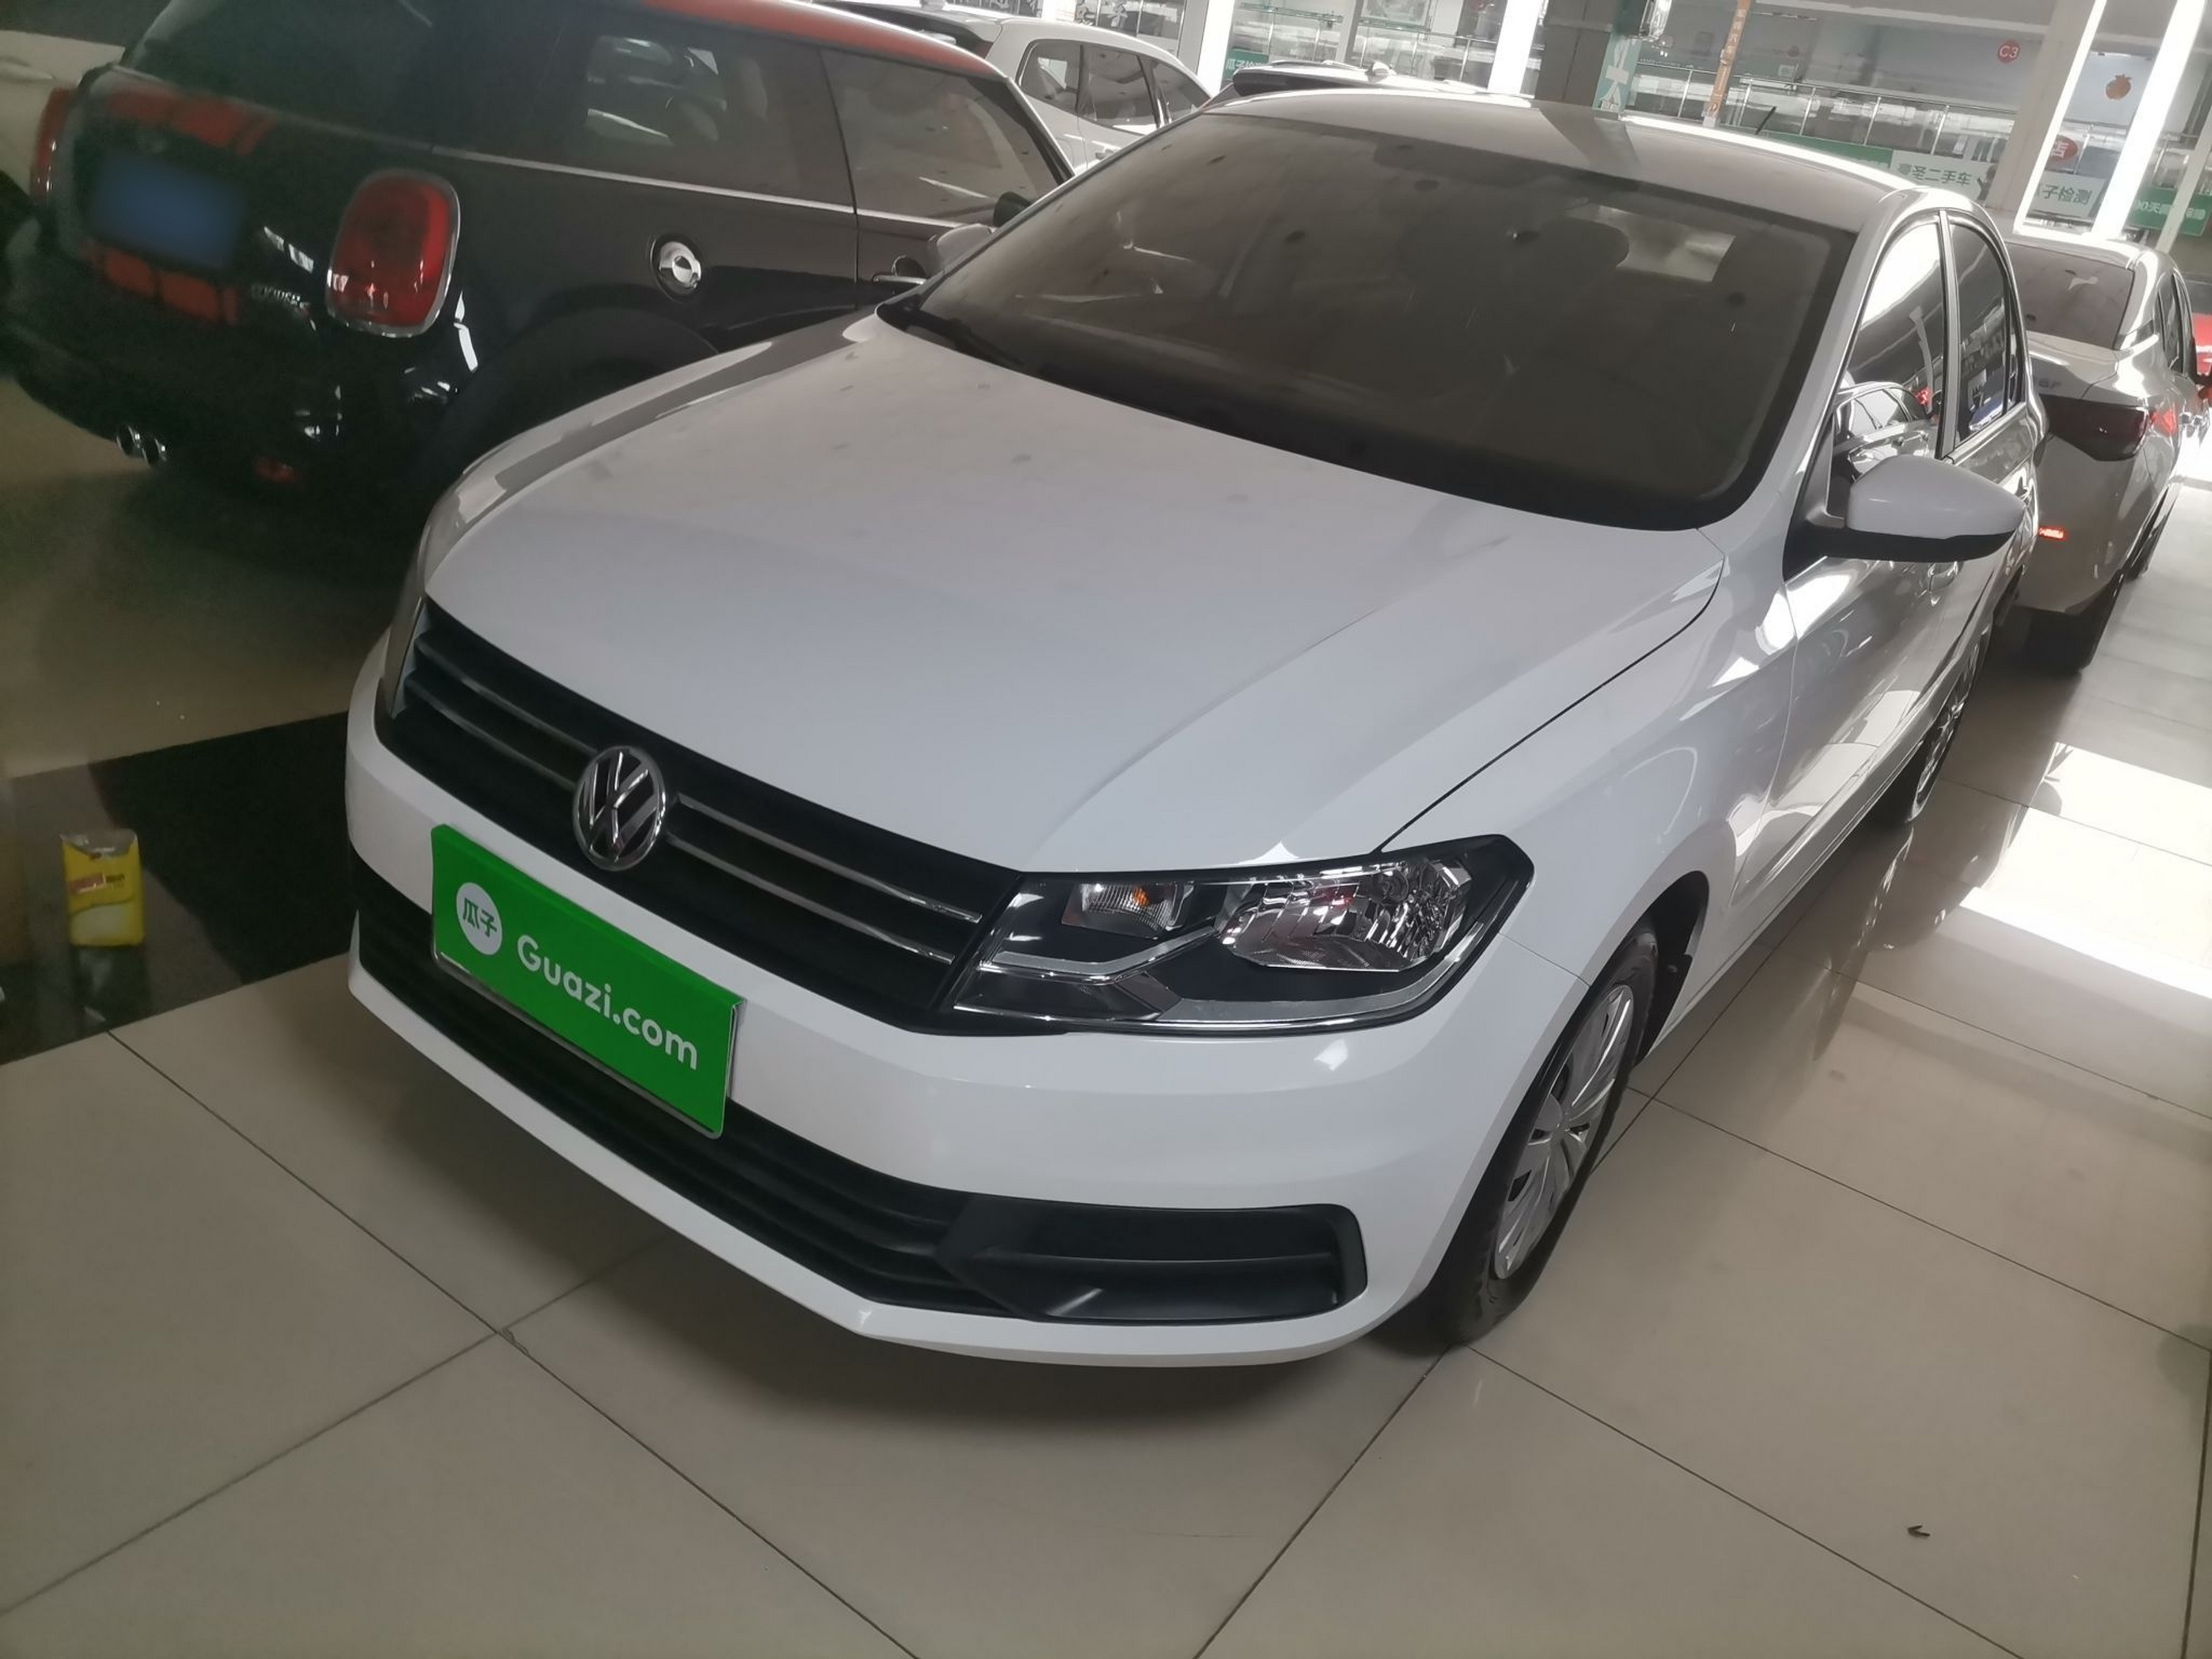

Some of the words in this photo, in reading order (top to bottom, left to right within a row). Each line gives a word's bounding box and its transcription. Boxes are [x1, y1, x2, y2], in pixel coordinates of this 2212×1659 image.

[1999, 45, 2019, 58] C3
[463, 897, 498, 938] 瓜子
[517, 934, 698, 1071] Guazi.com
